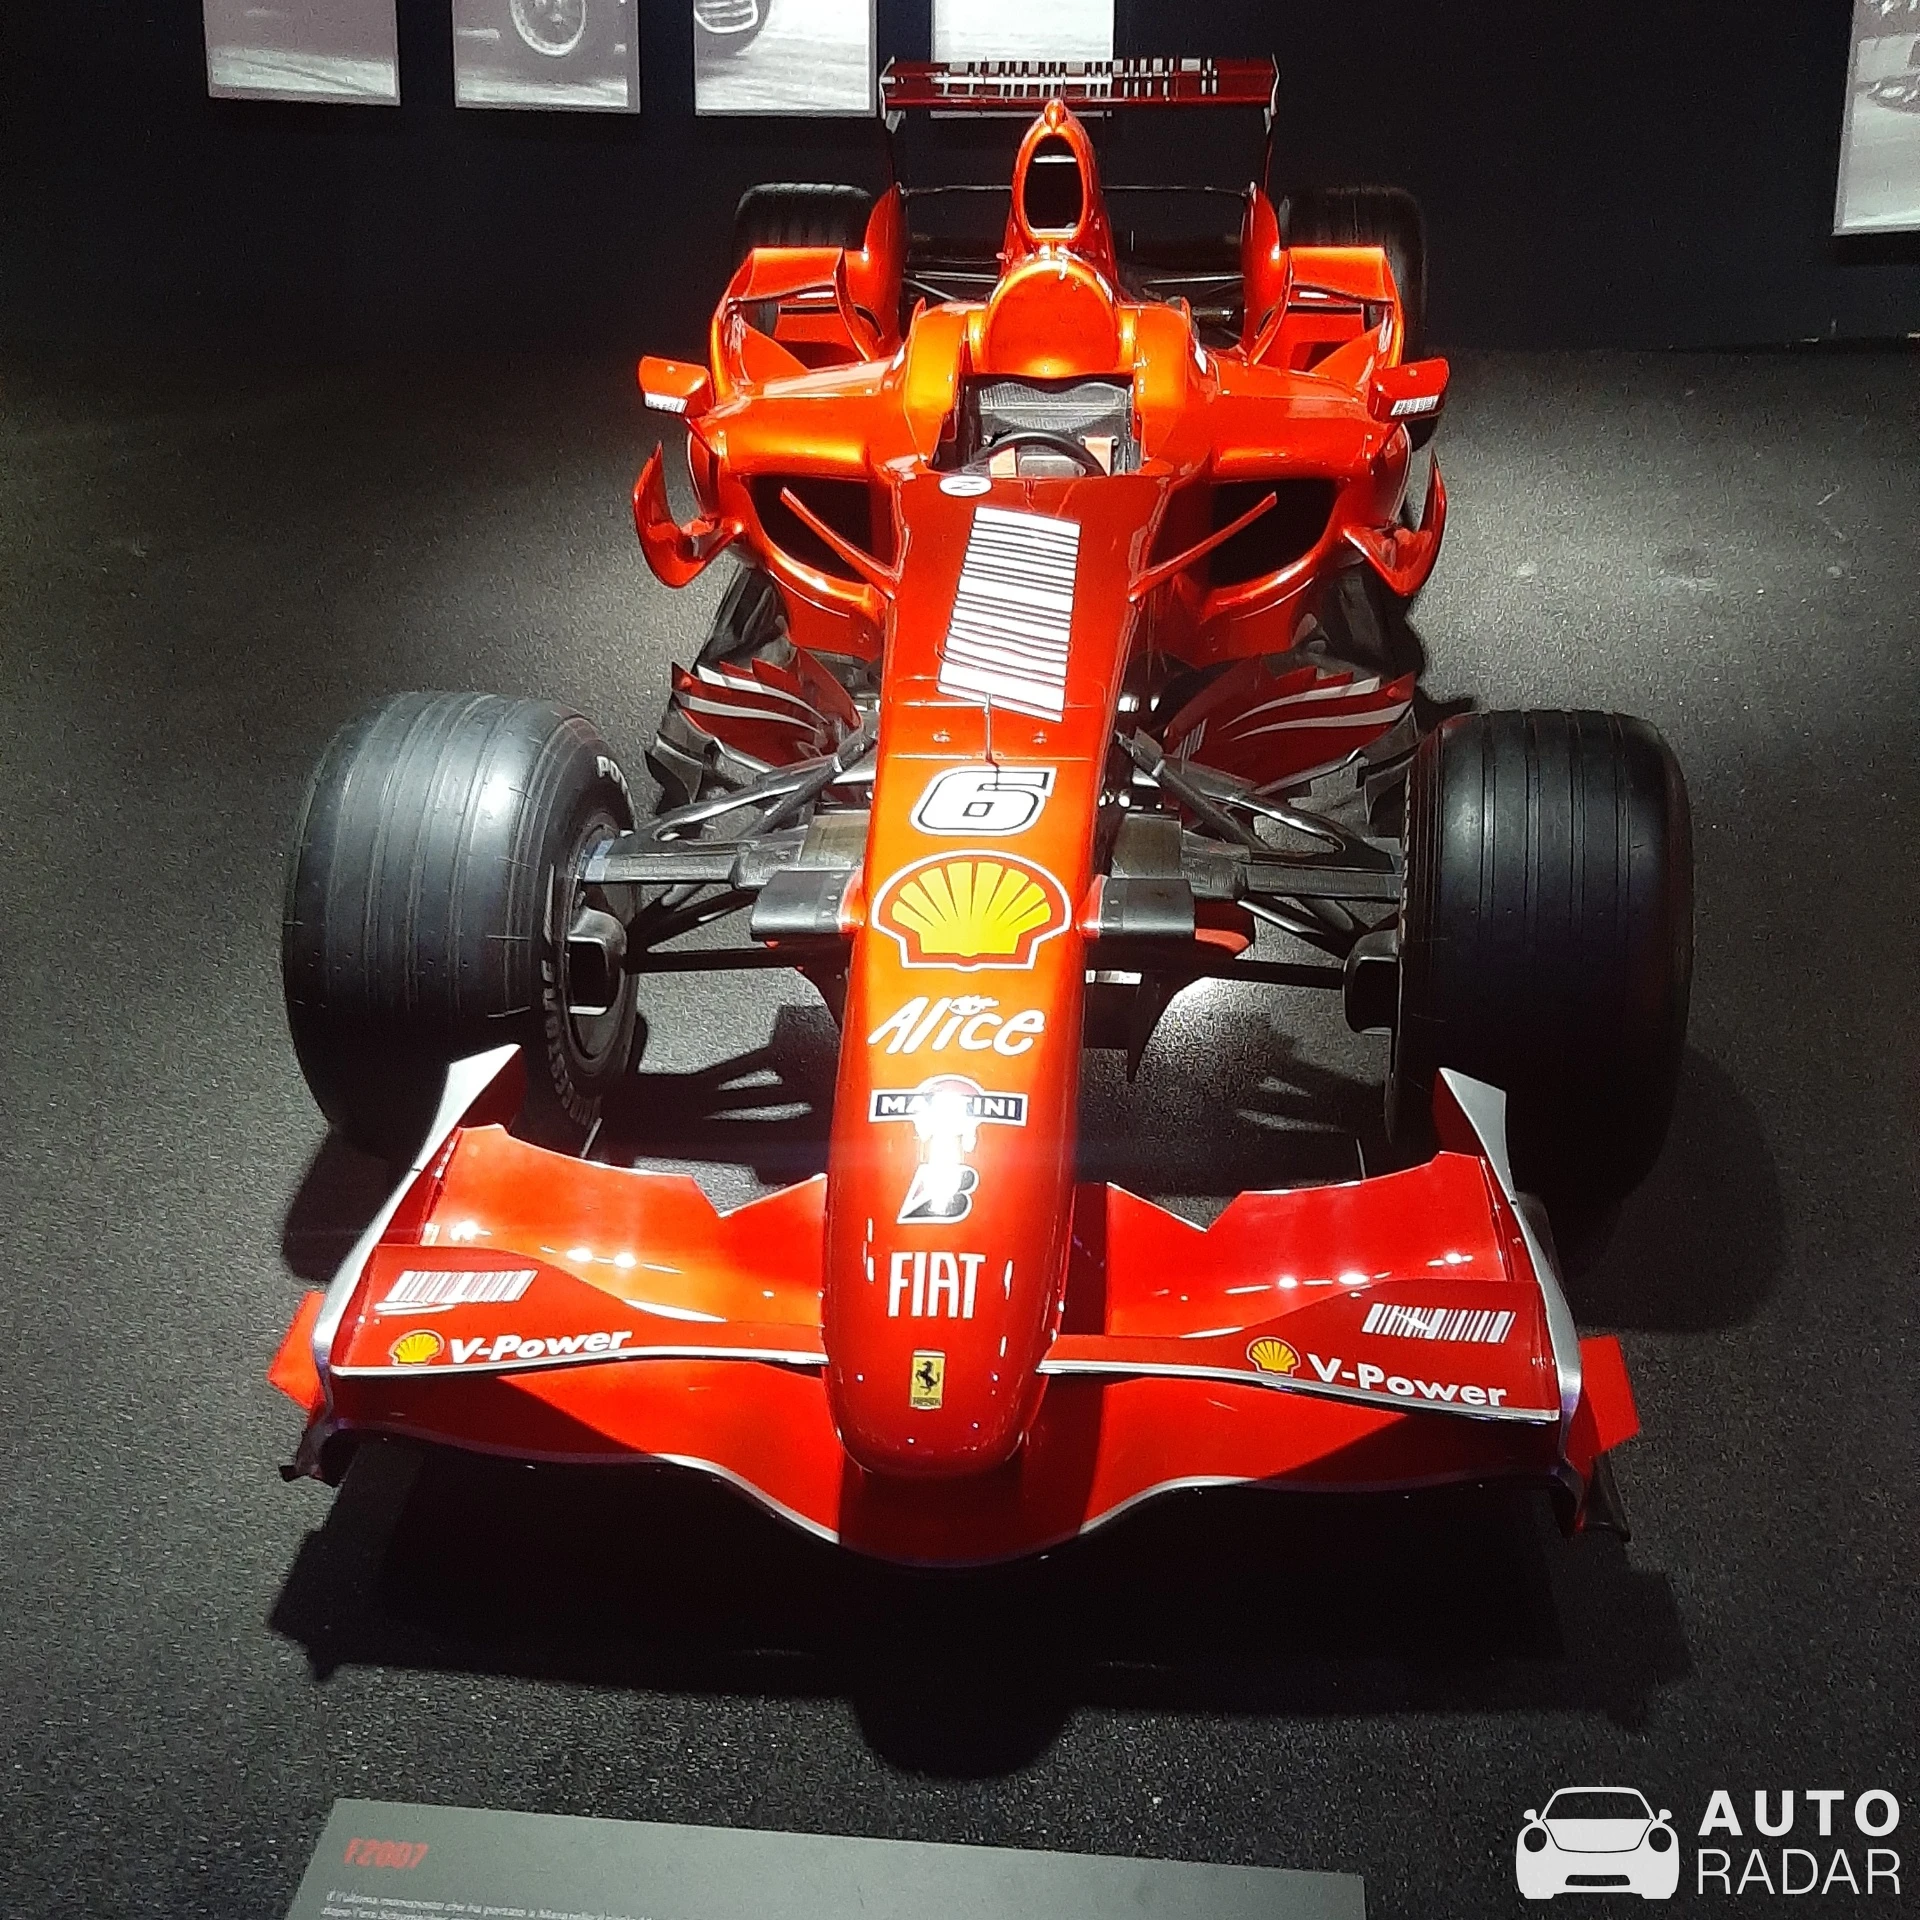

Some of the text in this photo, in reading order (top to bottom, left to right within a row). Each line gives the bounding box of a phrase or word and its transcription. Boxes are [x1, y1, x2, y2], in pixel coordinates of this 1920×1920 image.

[909, 766, 1057, 836] 6
[540, 959, 603, 1134] DGESTONE
[867, 995, 1046, 1056] Alice
[880, 1095, 1018, 1119] MAINI
[888, 1251, 987, 1319] FIAT
[450, 1330, 633, 1364] V-Power
[1307, 1353, 1508, 1407] V-Power
[343, 1837, 429, 1870] F2007
